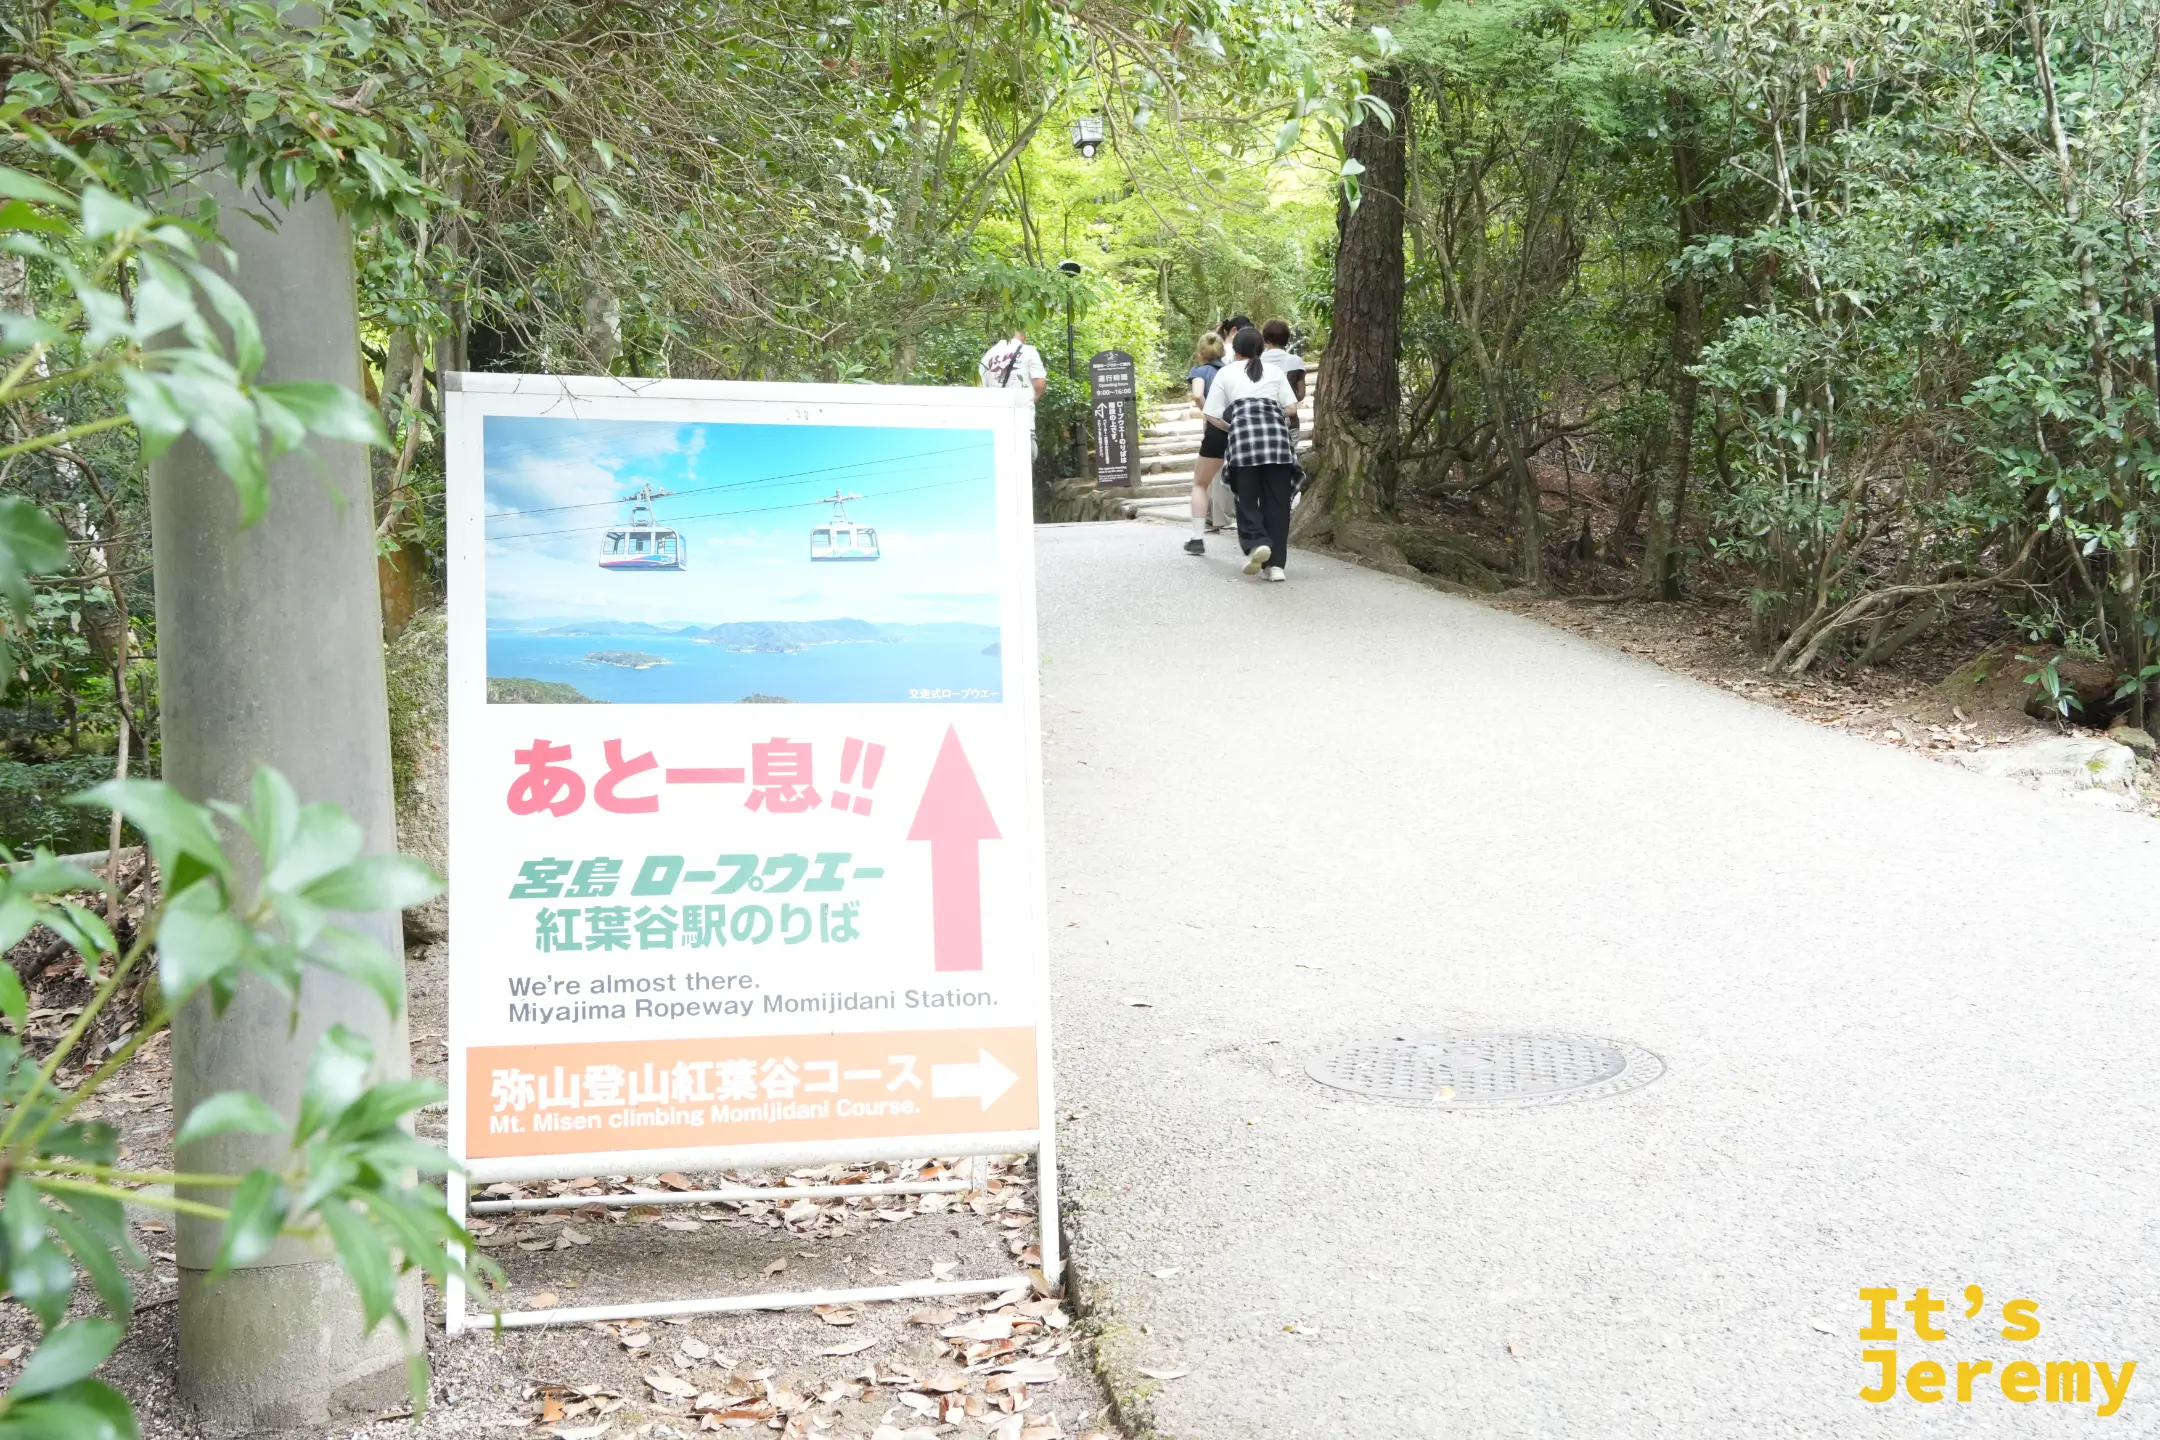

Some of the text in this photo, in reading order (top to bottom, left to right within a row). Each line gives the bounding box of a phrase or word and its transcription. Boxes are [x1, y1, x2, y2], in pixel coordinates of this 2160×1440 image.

[508, 852, 886, 900] 宮島 ロープウエー
[535, 901, 861, 953] 紅葉谷駅のりば
[508, 971, 761, 997] We’re almost there.
[508, 987, 999, 1024] Miyajima Ropeway Momijidani Station.
[490, 1053, 924, 1112] 弥山登山紅葉谷コース
[489, 1098, 921, 1134] Mt. Misen climbing Momijidani Course.
